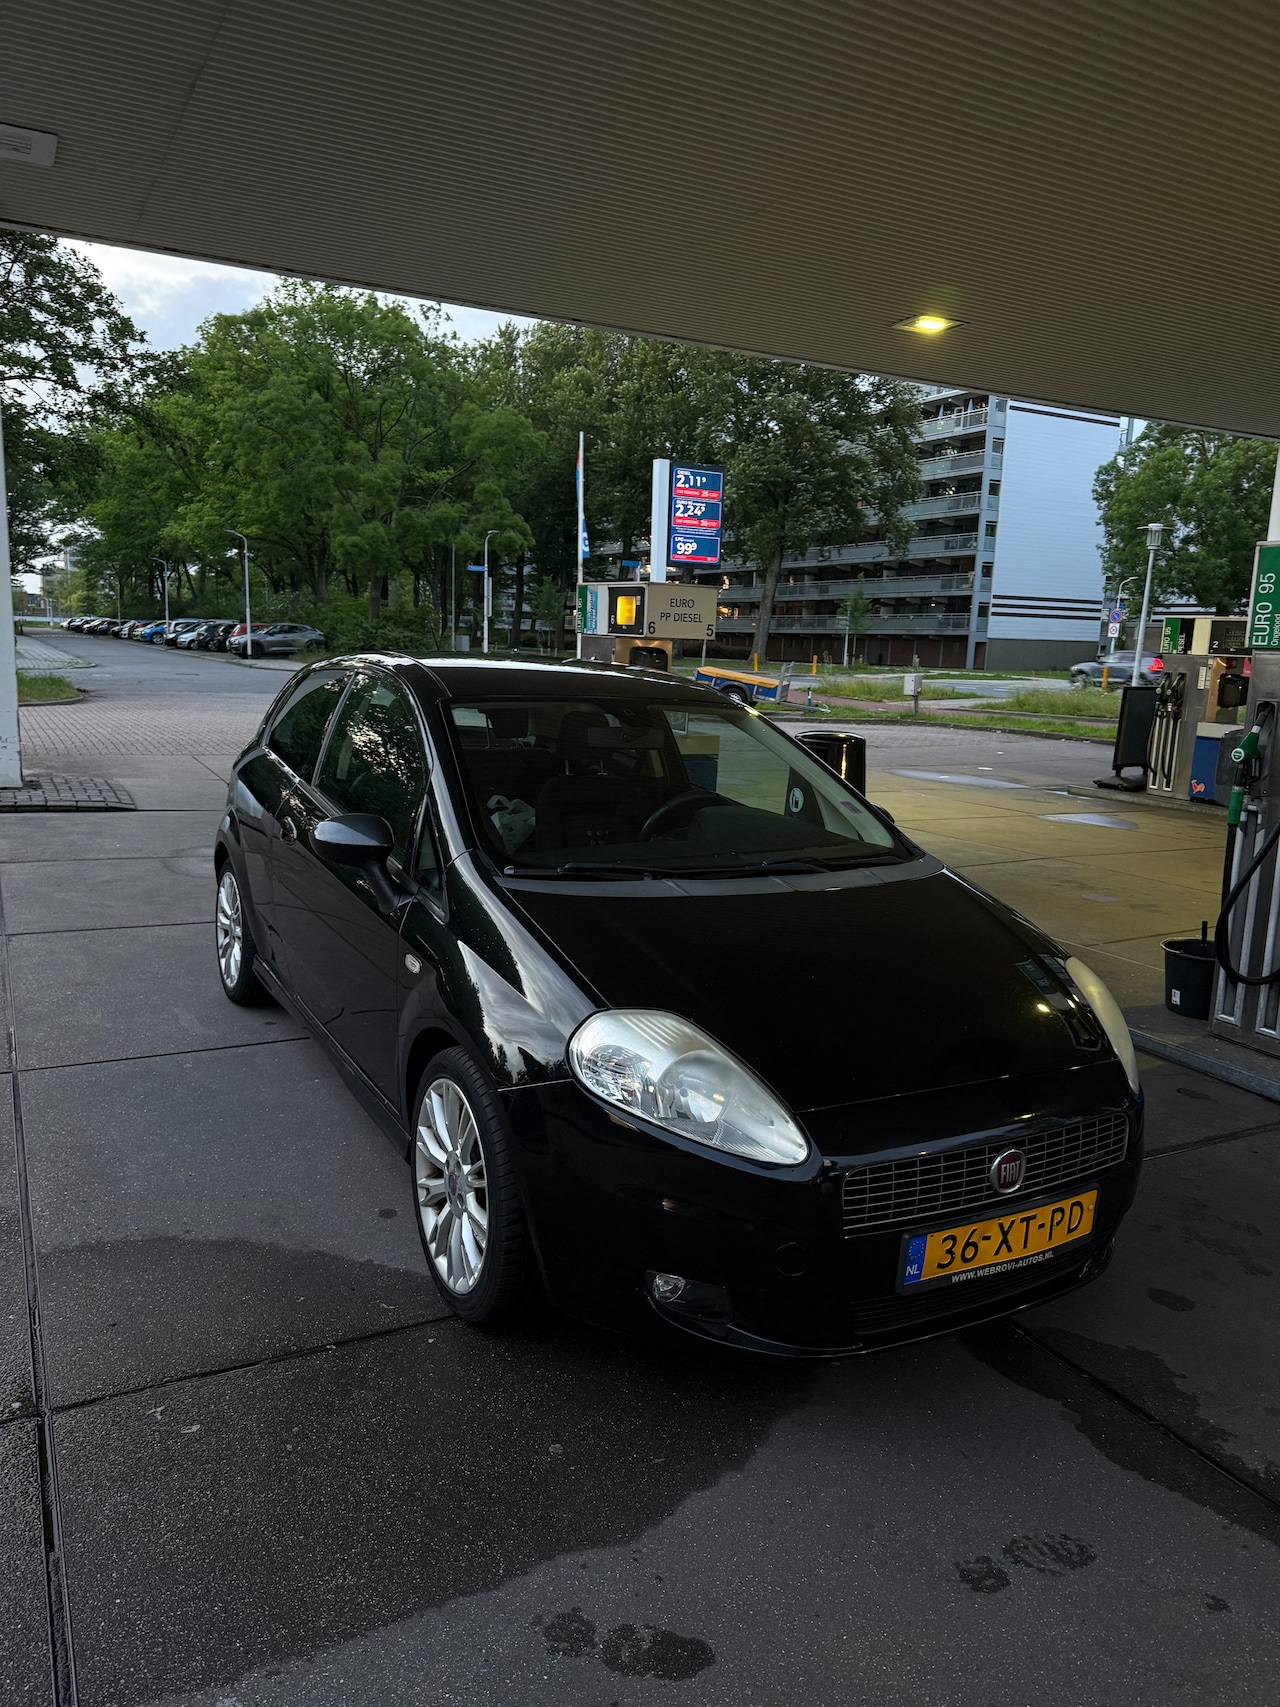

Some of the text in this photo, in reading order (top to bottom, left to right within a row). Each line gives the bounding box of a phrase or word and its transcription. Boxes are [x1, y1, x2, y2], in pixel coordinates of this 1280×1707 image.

[669, 598, 695, 609] EURO
[1252, 572, 1276, 646] EURO 95
[610, 614, 616, 625] 6
[660, 612, 703, 623] PP DIESEL
[648, 621, 656, 635] 6
[706, 624, 714, 637] 5
[1162, 637, 1170, 653] EURO
[1177, 633, 1186, 654] DIESEL
[1212, 640, 1219, 648] 2
[1000, 1160, 1021, 1185] FIAT
[936, 1200, 1084, 1269] 36-XT-PD
[905, 1263, 920, 1276] NL
[951, 1250, 1054, 1283] WWW.WEBROVI-AUTOS.NL
